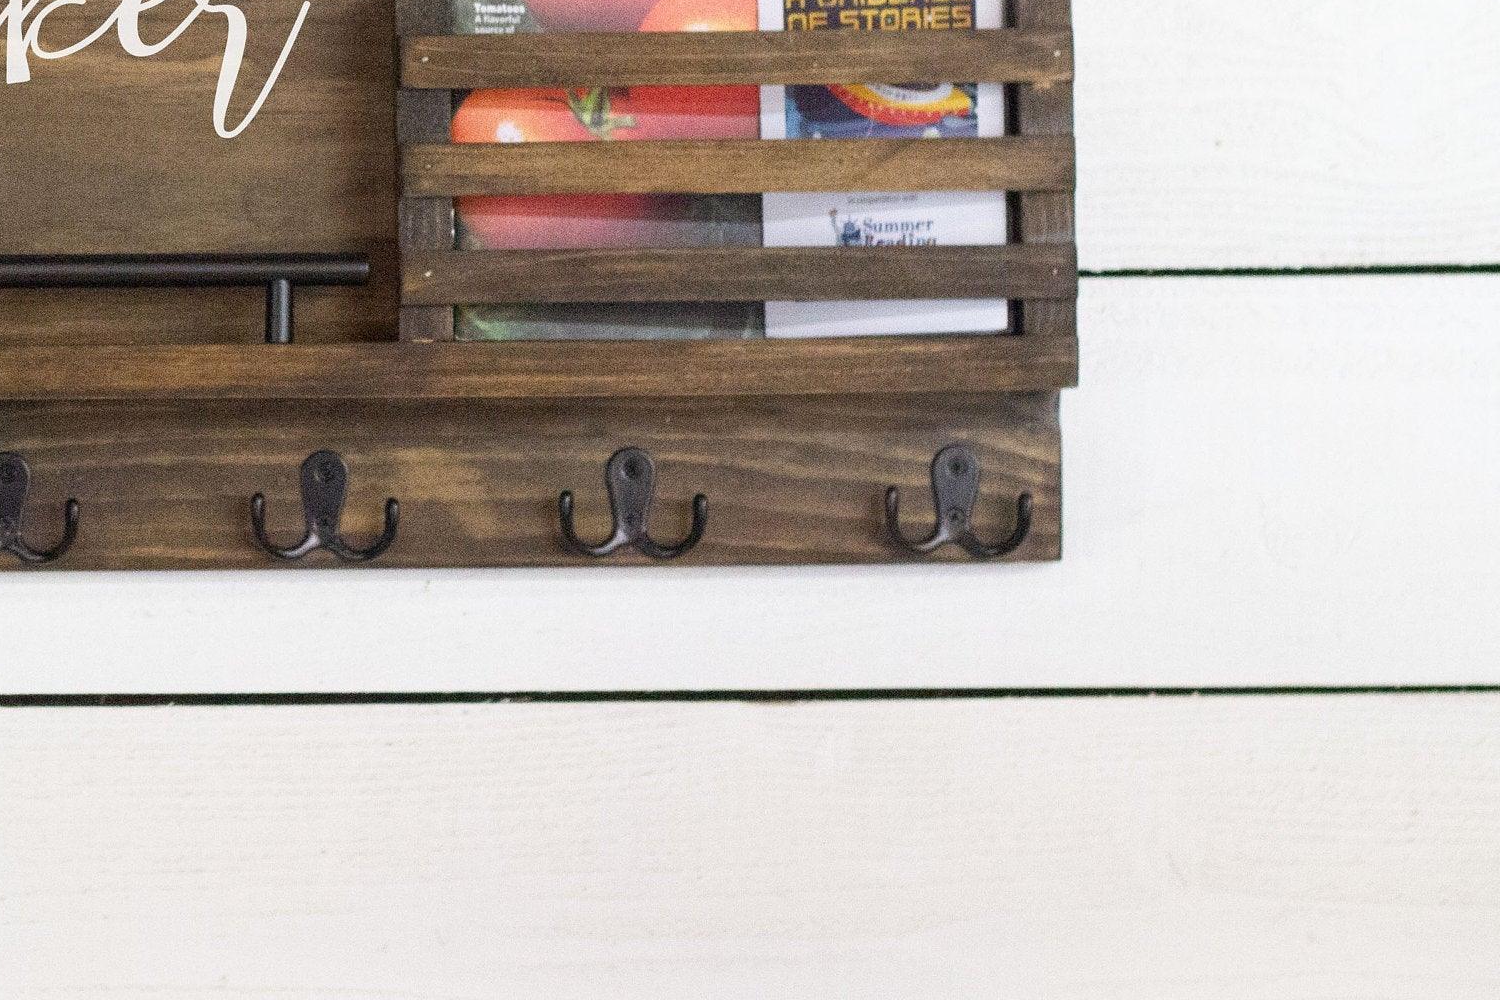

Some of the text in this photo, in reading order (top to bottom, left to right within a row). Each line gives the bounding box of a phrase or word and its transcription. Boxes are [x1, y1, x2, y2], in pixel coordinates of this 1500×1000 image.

[474, 2, 526, 14] Tomatoes
[474, 14, 482, 24] A
[839, 5, 973, 31] STORIES
[863, 217, 934, 233] Summer
